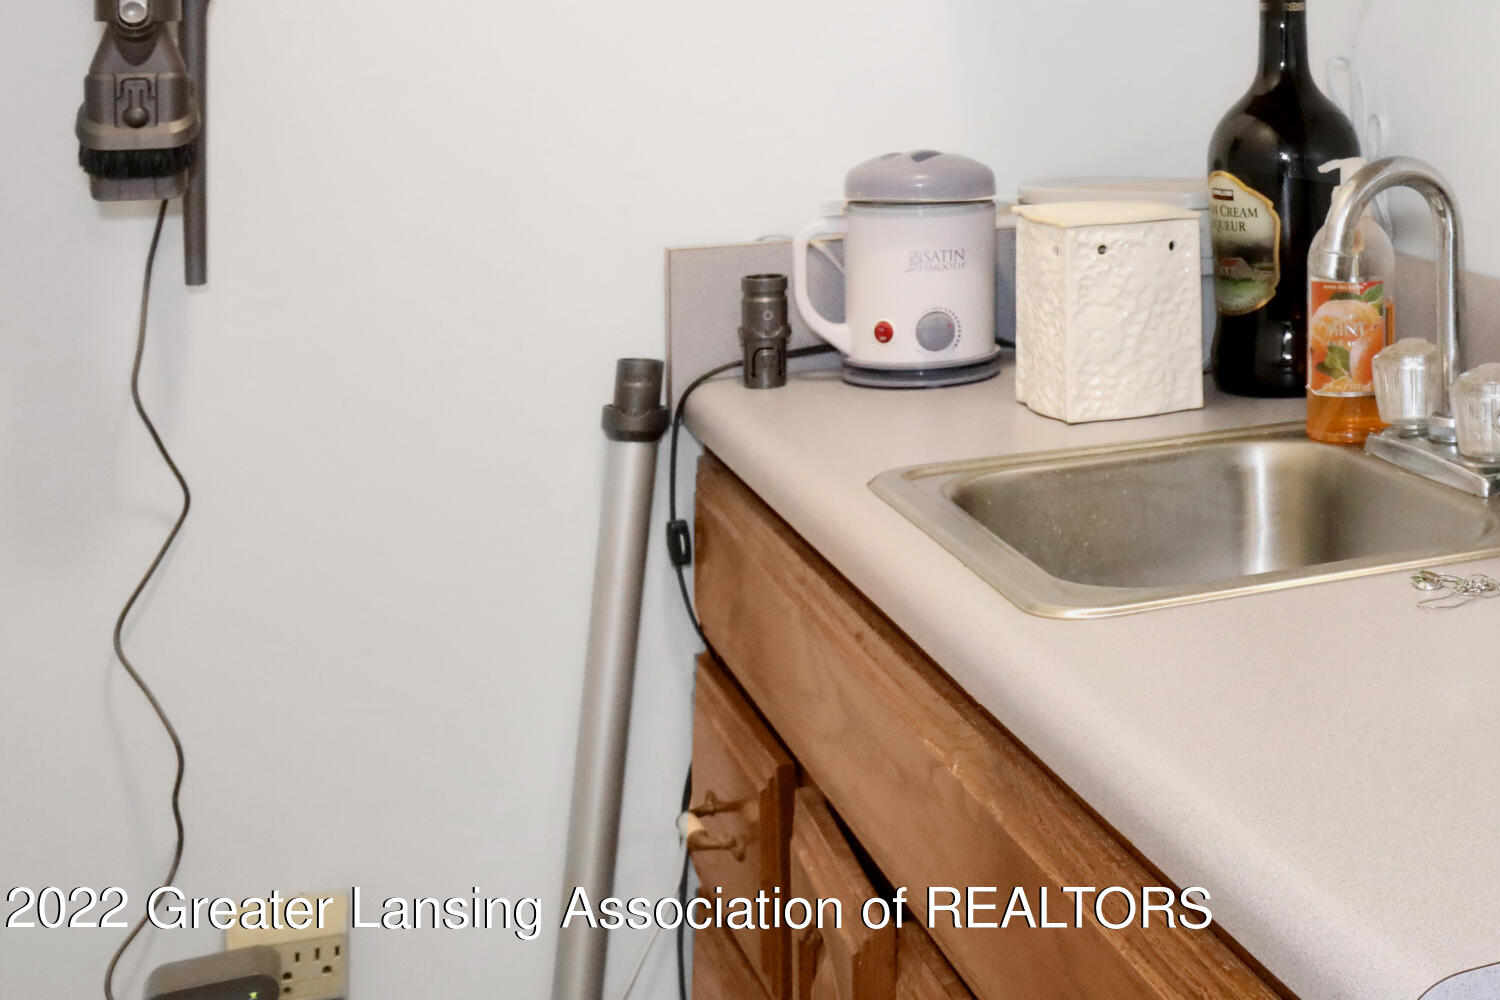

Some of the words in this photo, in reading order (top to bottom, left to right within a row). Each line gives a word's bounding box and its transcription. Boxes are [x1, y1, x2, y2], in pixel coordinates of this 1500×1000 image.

[1219, 204, 1258, 218] CREAM
[1215, 219, 1247, 233] QUEUR
[924, 247, 965, 263] SATIN
